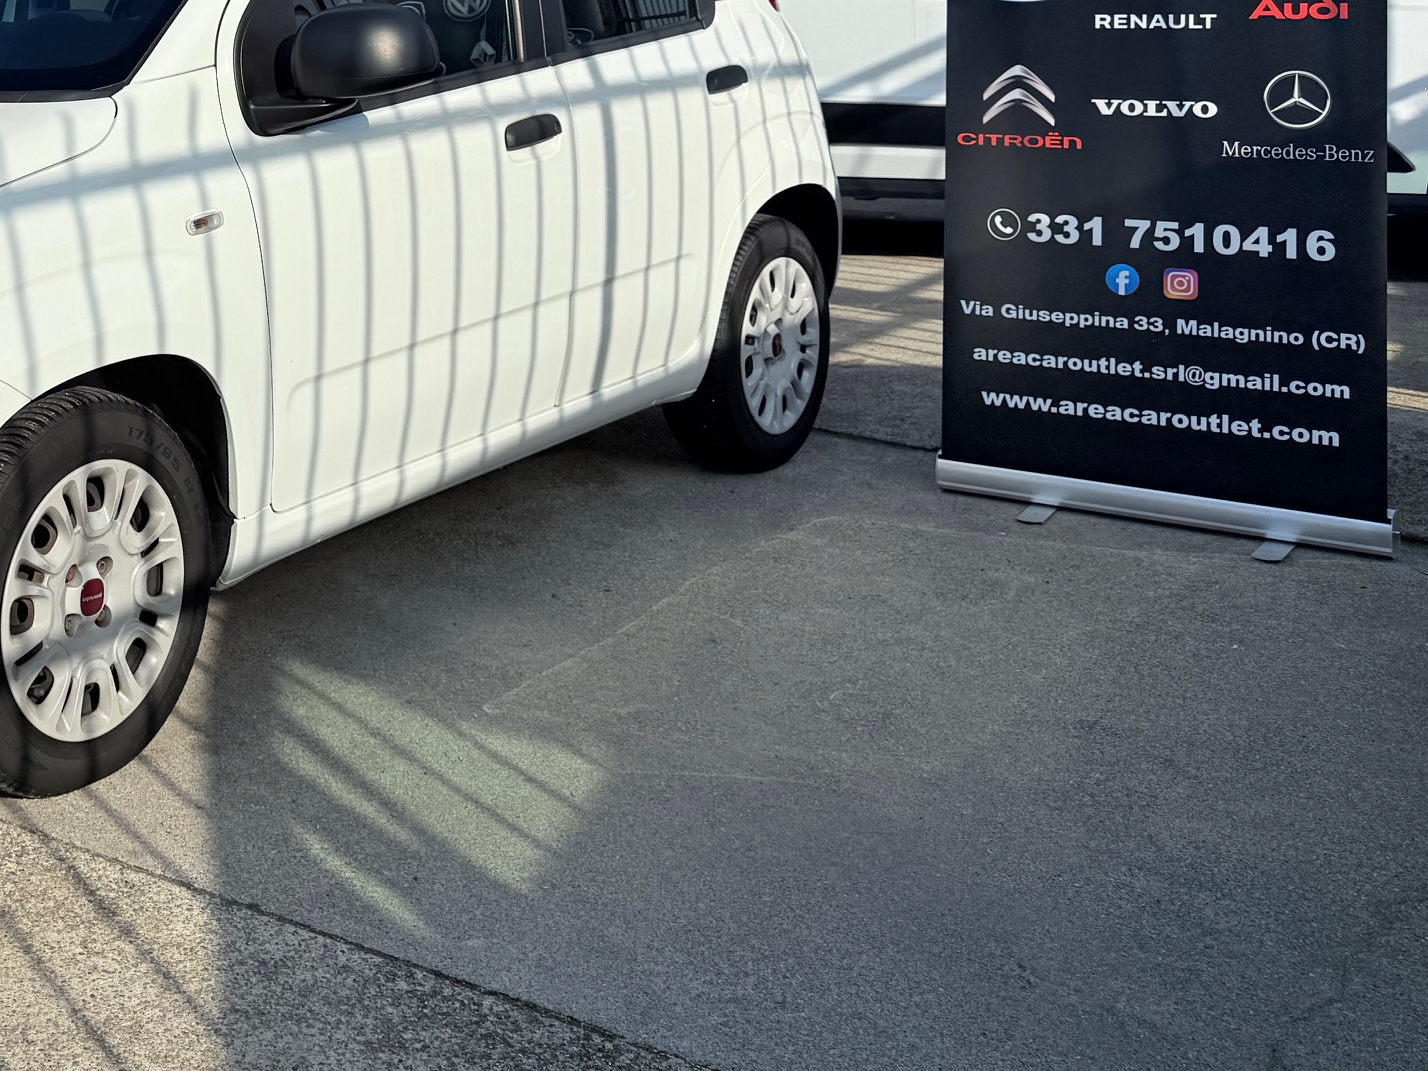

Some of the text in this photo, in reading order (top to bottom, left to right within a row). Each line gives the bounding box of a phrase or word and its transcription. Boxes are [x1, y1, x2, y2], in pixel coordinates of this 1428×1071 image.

[1094, 13, 1217, 30] RENAULT
[1091, 98, 1218, 119] VOLVO
[1221, 141, 1375, 164] Mercedes-Benz
[1026, 212, 1336, 262] 331 7510416
[960, 300, 1365, 355] Via Giuseppina 33, Malagnino (CR)
[972, 345, 1350, 400] areacaroutlet.srl@gmail.com
[981, 390, 1340, 447] www.areacaroutlet.com
